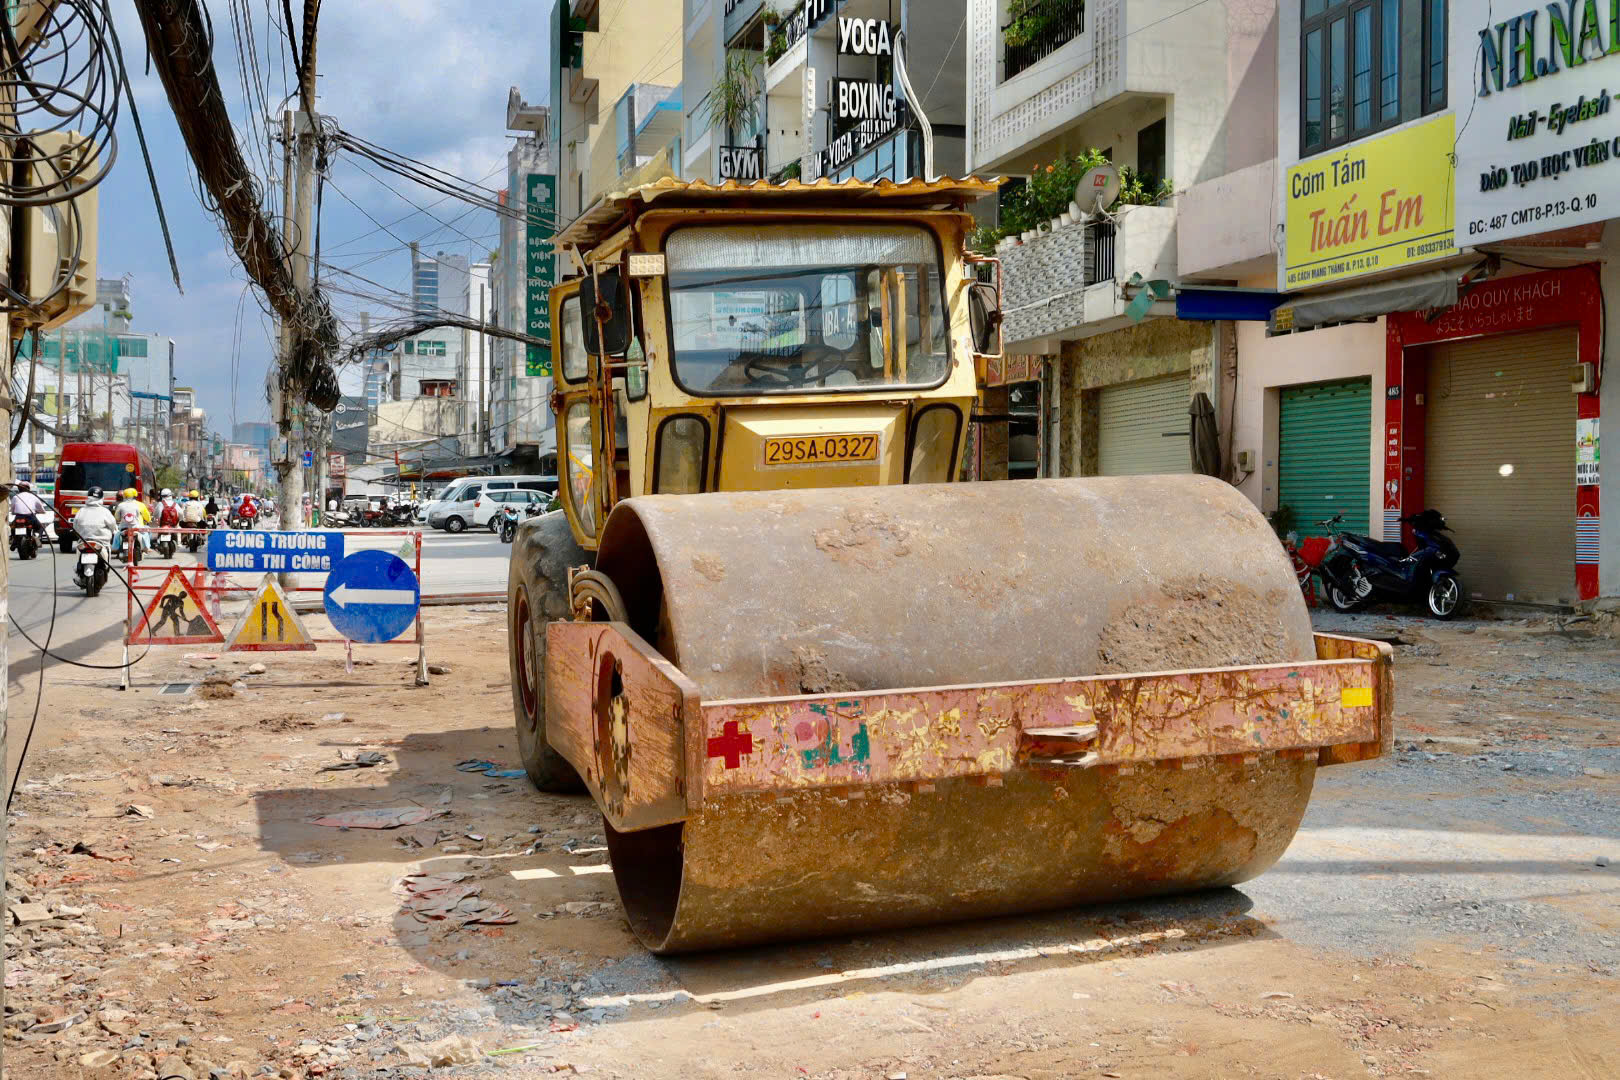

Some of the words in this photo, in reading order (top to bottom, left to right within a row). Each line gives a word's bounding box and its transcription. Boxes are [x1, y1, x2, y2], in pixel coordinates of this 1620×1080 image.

[839, 17, 891, 55] YOGA
[839, 81, 893, 120] BOXING
[1507, 109, 1537, 141] Nail
[1547, 88, 1610, 135] Eyelash
[720, 151, 760, 179] GYM
[829, 132, 853, 169] YOGA
[1292, 171, 1325, 199] Cơm
[1331, 153, 1366, 188] Tấm
[1480, 165, 1508, 192] ĐÀO
[1511, 160, 1539, 188] TẠO
[1541, 150, 1571, 180] HỌC
[1309, 193, 1369, 253] Tuấn
[1377, 189, 1424, 236] Em
[1469, 220, 1487, 235] ĐC:
[1490, 214, 1508, 231] 487
[528, 279, 553, 288] KHOA
[531, 319, 551, 328] GÒN
[769, 437, 874, 461] 29SA-0327
[225, 531, 265, 549] CÔNG
[215, 553, 254, 568] ĐANG
[262, 554, 286, 569] THI
[291, 552, 331, 570] CÔNG
